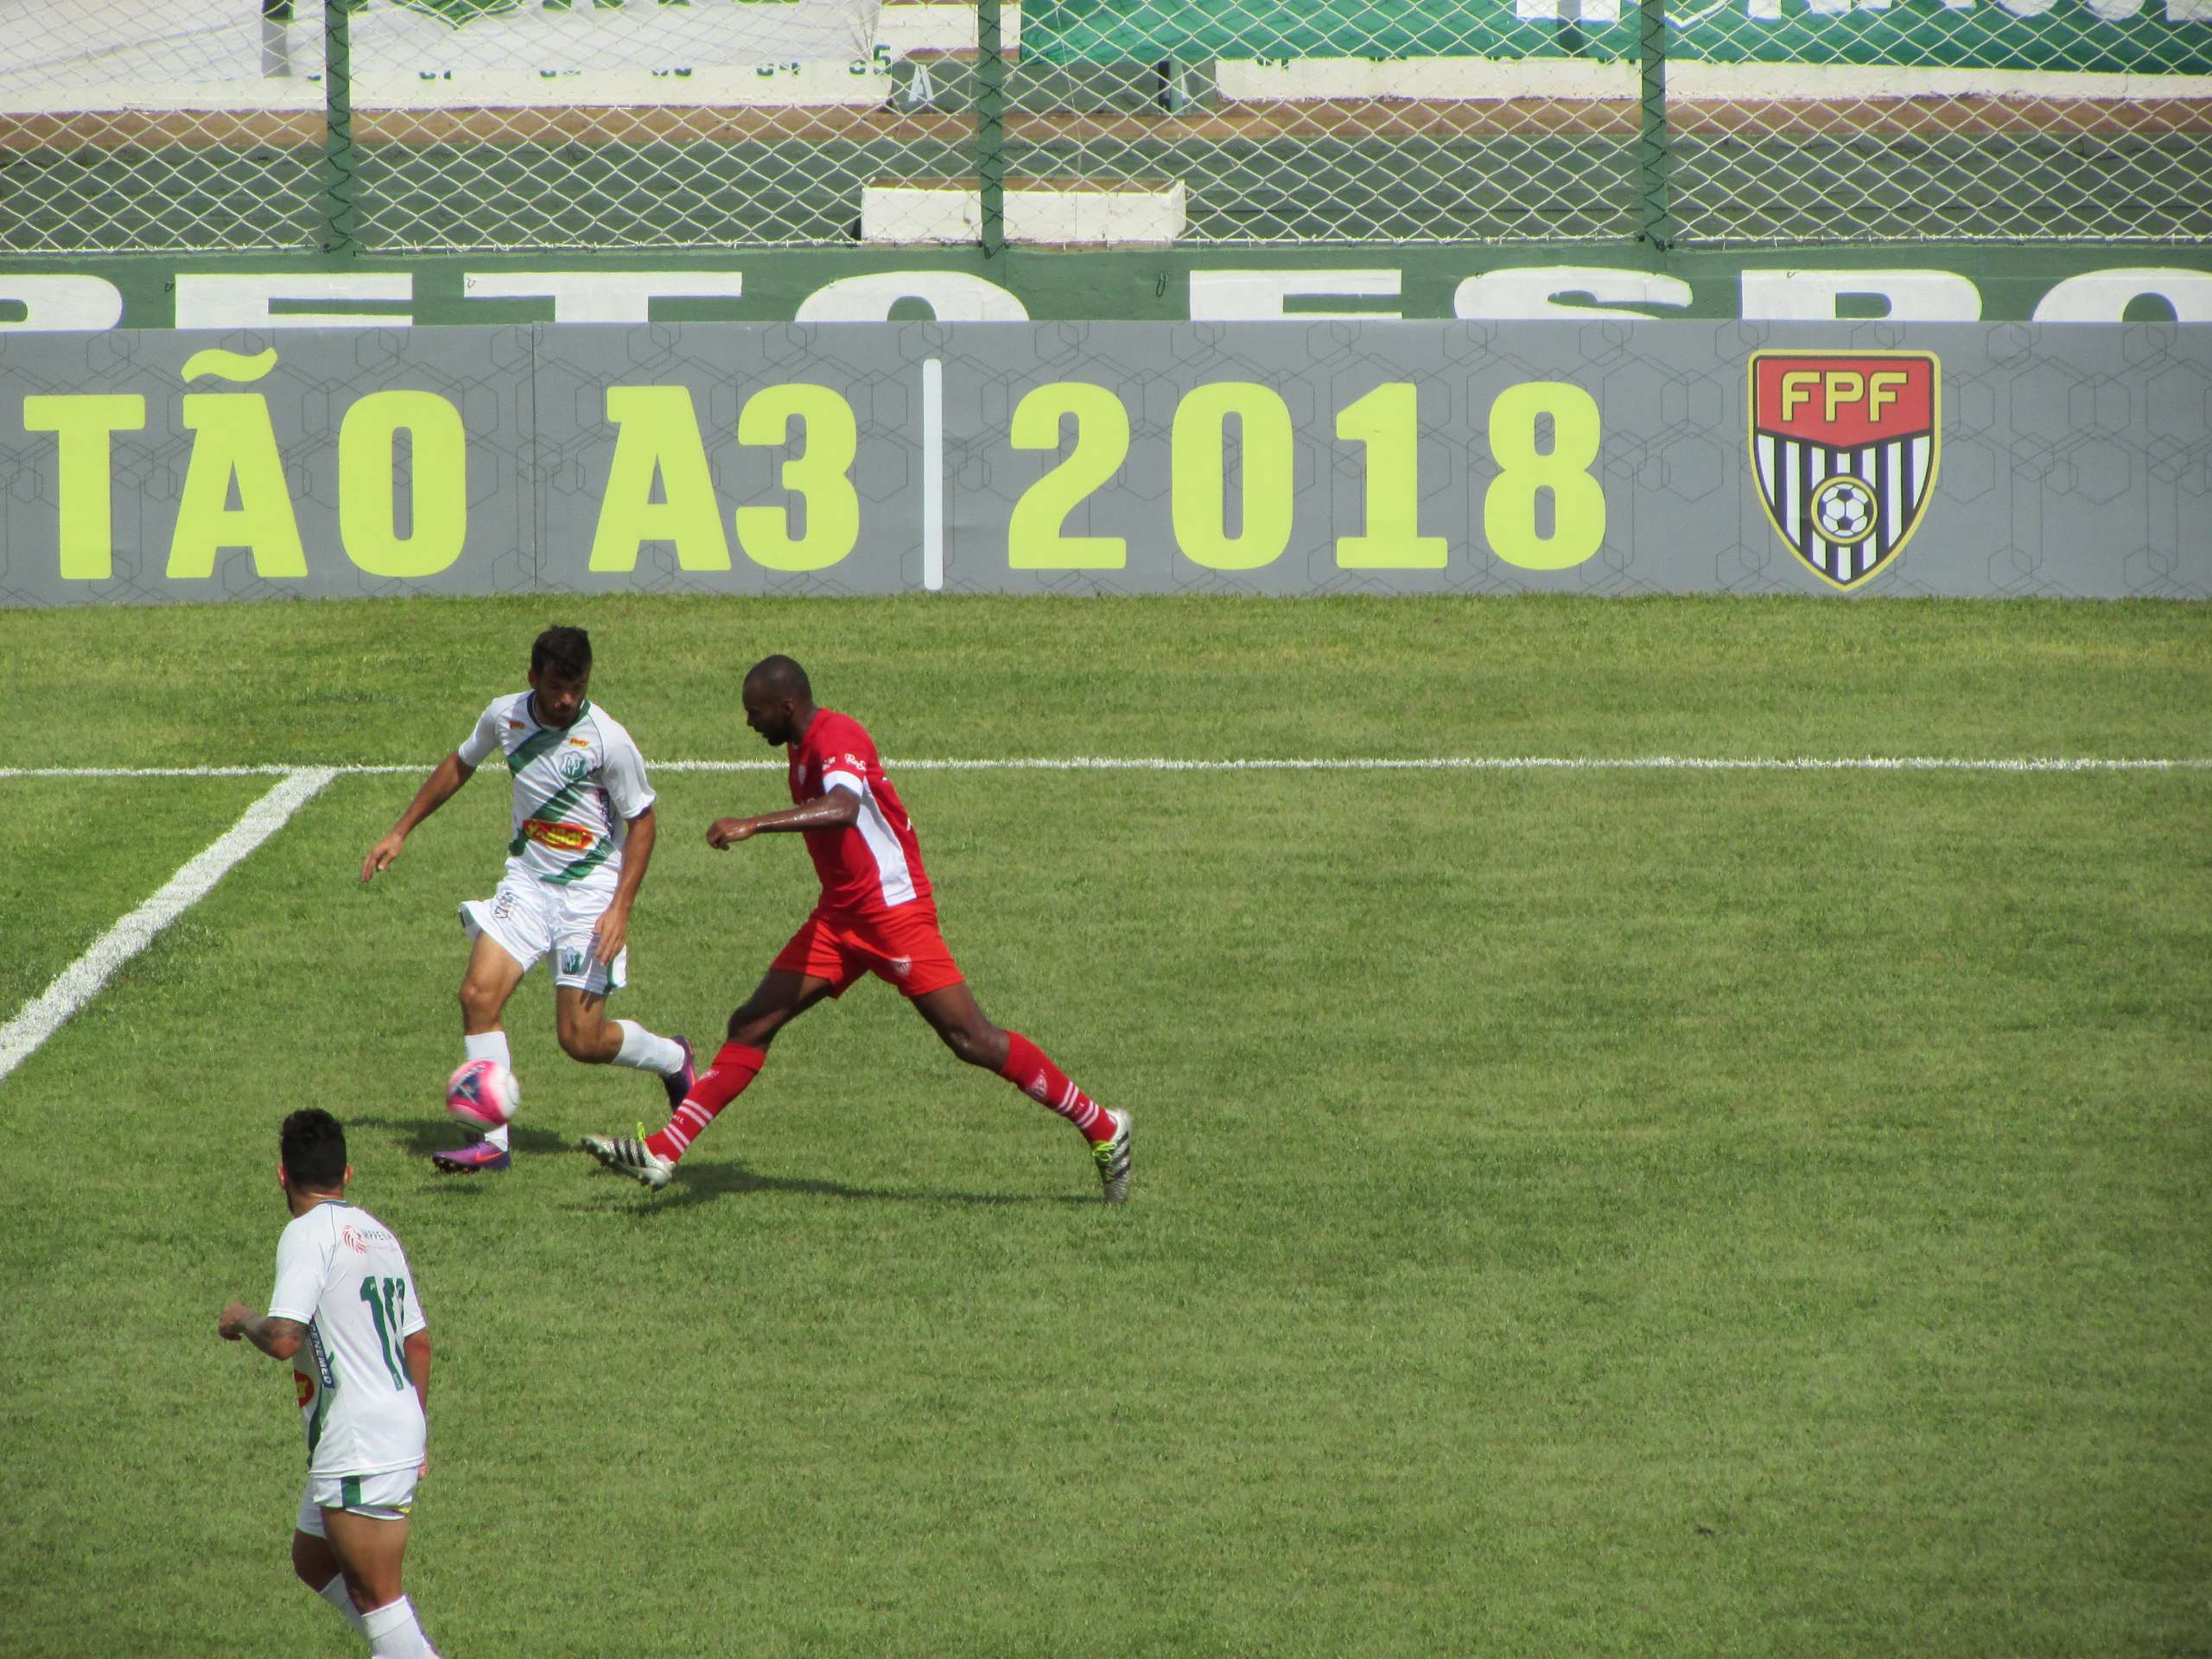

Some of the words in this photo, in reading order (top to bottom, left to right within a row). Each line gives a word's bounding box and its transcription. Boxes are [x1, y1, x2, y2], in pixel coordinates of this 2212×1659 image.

[0, 272, 1029, 329] ETO
[1782, 372, 1907, 422] FPF
[23, 347, 467, 581] TÃO
[588, 383, 861, 573] A3
[1007, 380, 1606, 572] 2018
